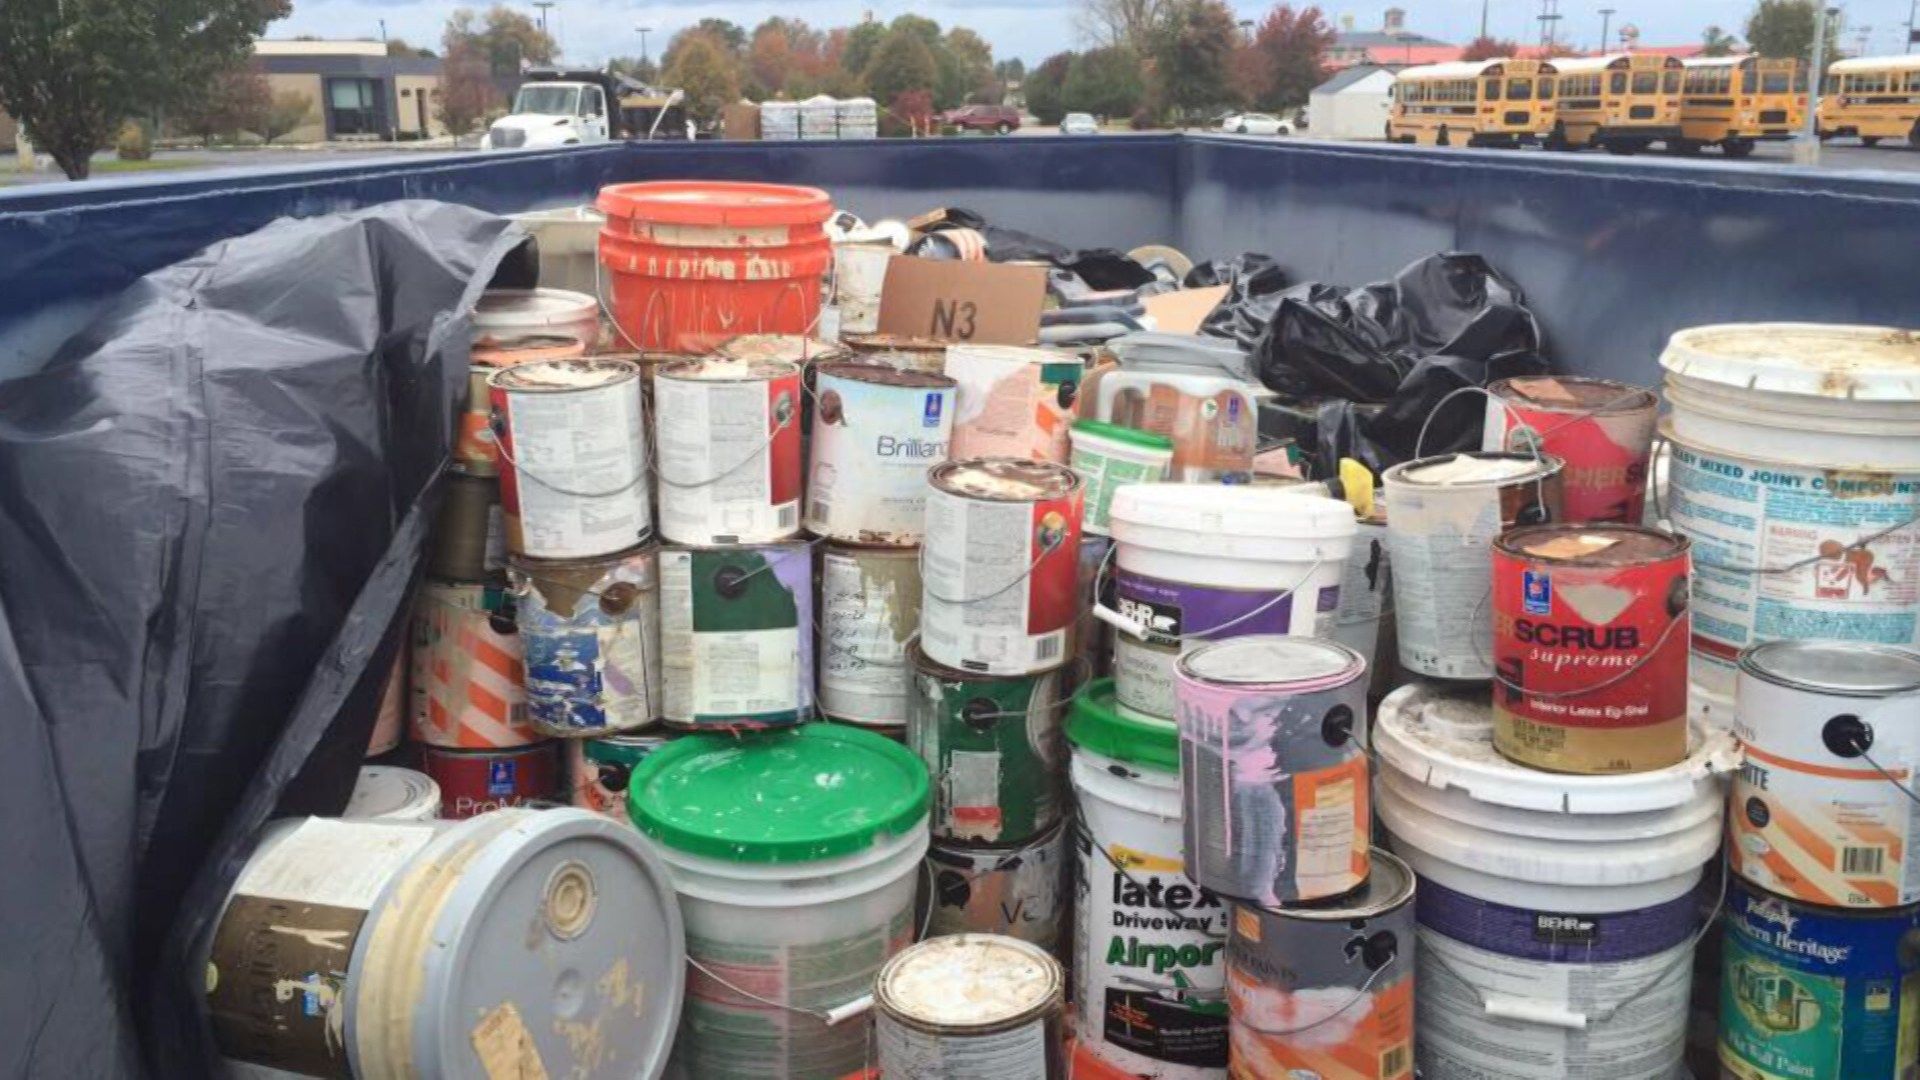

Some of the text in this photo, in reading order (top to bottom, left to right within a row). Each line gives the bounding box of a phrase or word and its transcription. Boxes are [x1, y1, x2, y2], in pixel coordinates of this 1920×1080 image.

[931, 298, 977, 339] N3
[877, 435, 948, 457] Brillian
[1700, 459, 1743, 478] MIXED
[1750, 470, 1801, 488] JOINT
[1514, 618, 1639, 650] SCRUB
[1529, 648, 1638, 672] supreme
[1569, 705, 1601, 717] Latex
[455, 795, 523, 817] ProM
[1113, 871, 1222, 911] latex
[1113, 910, 1212, 932] Driveway
[1538, 914, 1579, 931] BEHR
[1106, 935, 1226, 974] Airpor
[1775, 930, 1849, 965] Heritage
